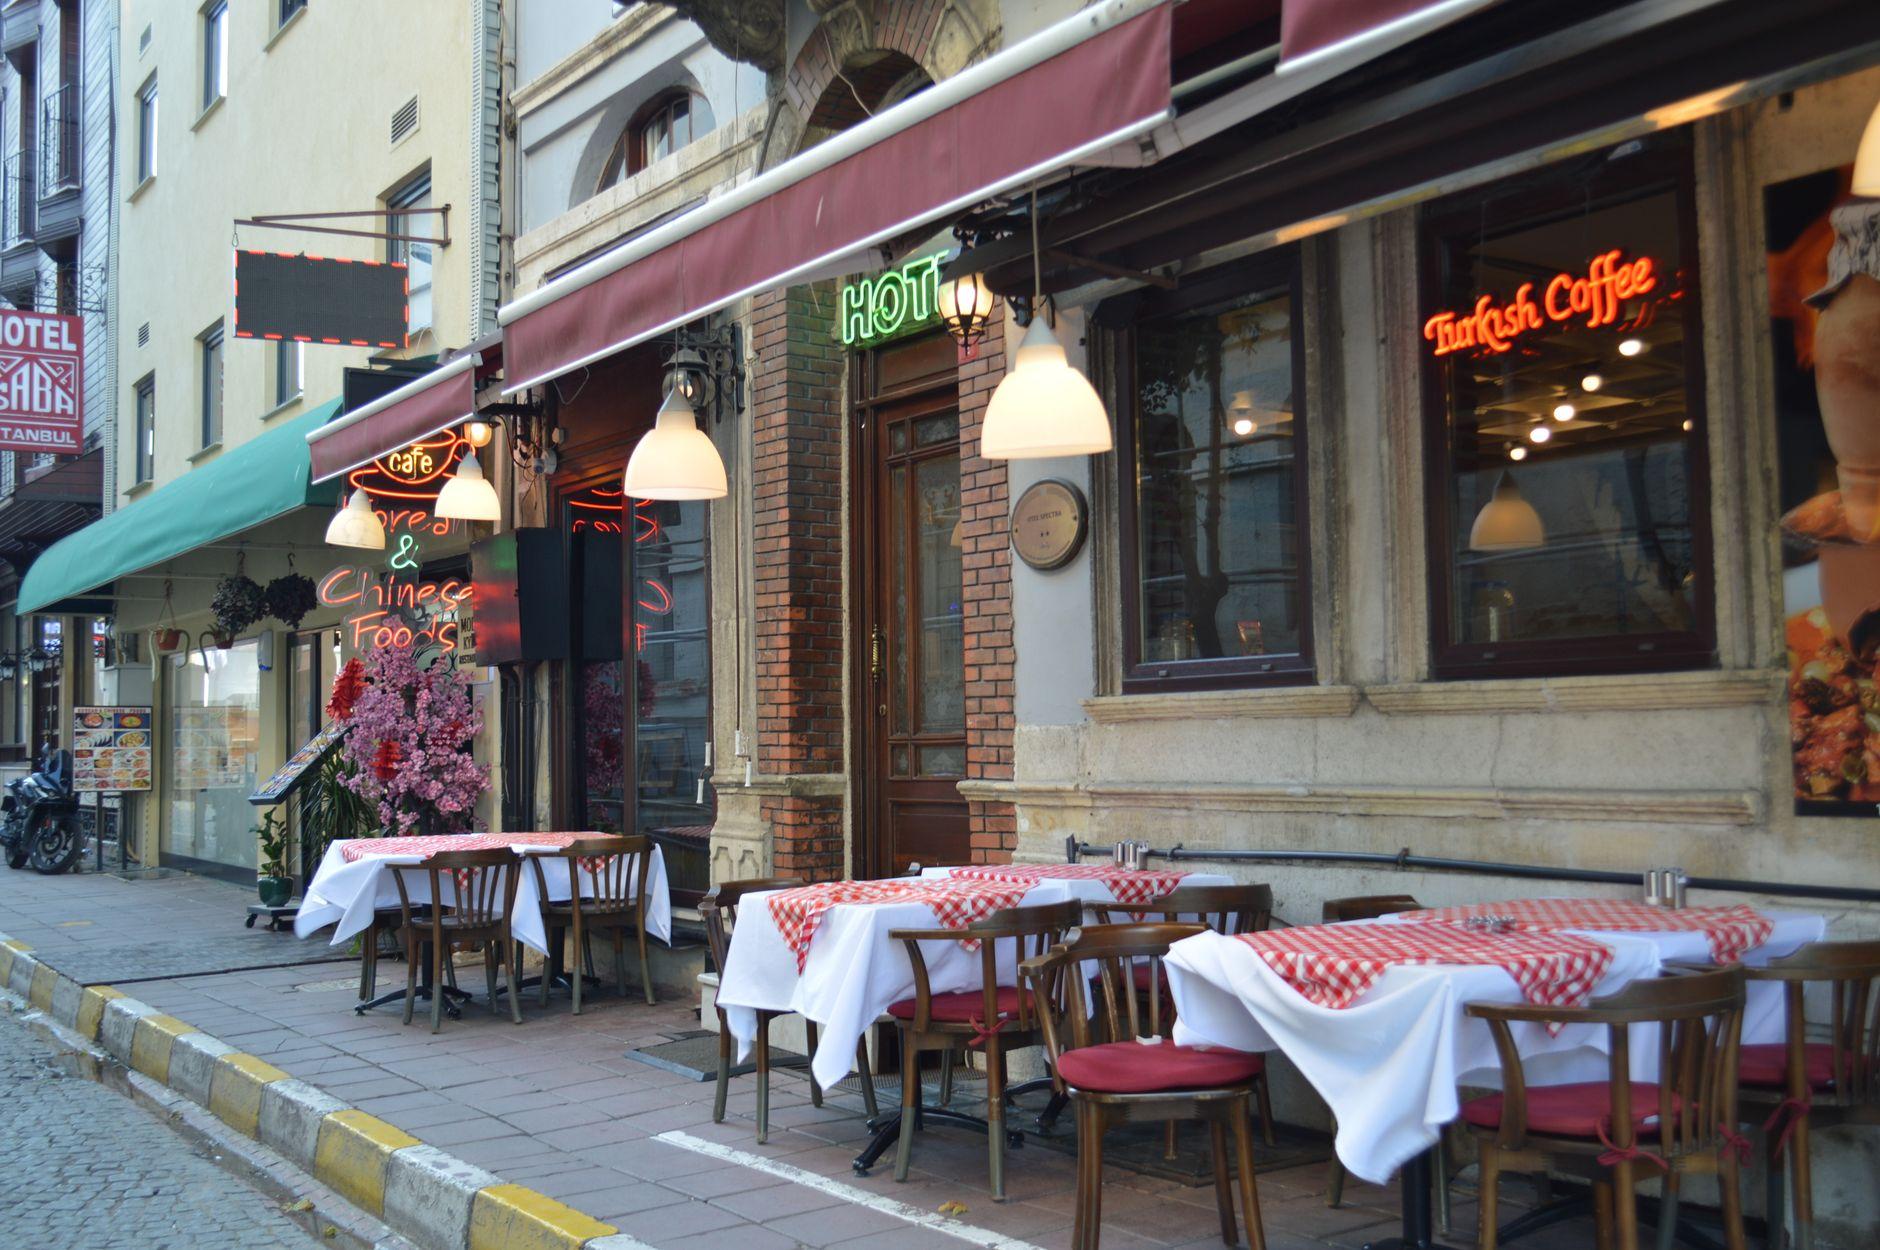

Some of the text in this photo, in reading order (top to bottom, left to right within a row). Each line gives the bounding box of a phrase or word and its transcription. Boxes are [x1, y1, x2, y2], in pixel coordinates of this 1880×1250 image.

[1424, 250, 1656, 356] Turkish Coffee
[0, 315, 77, 351] OTEL
[389, 446, 433, 480] cafe
[391, 534, 418, 569] &
[350, 610, 457, 653] Foods
